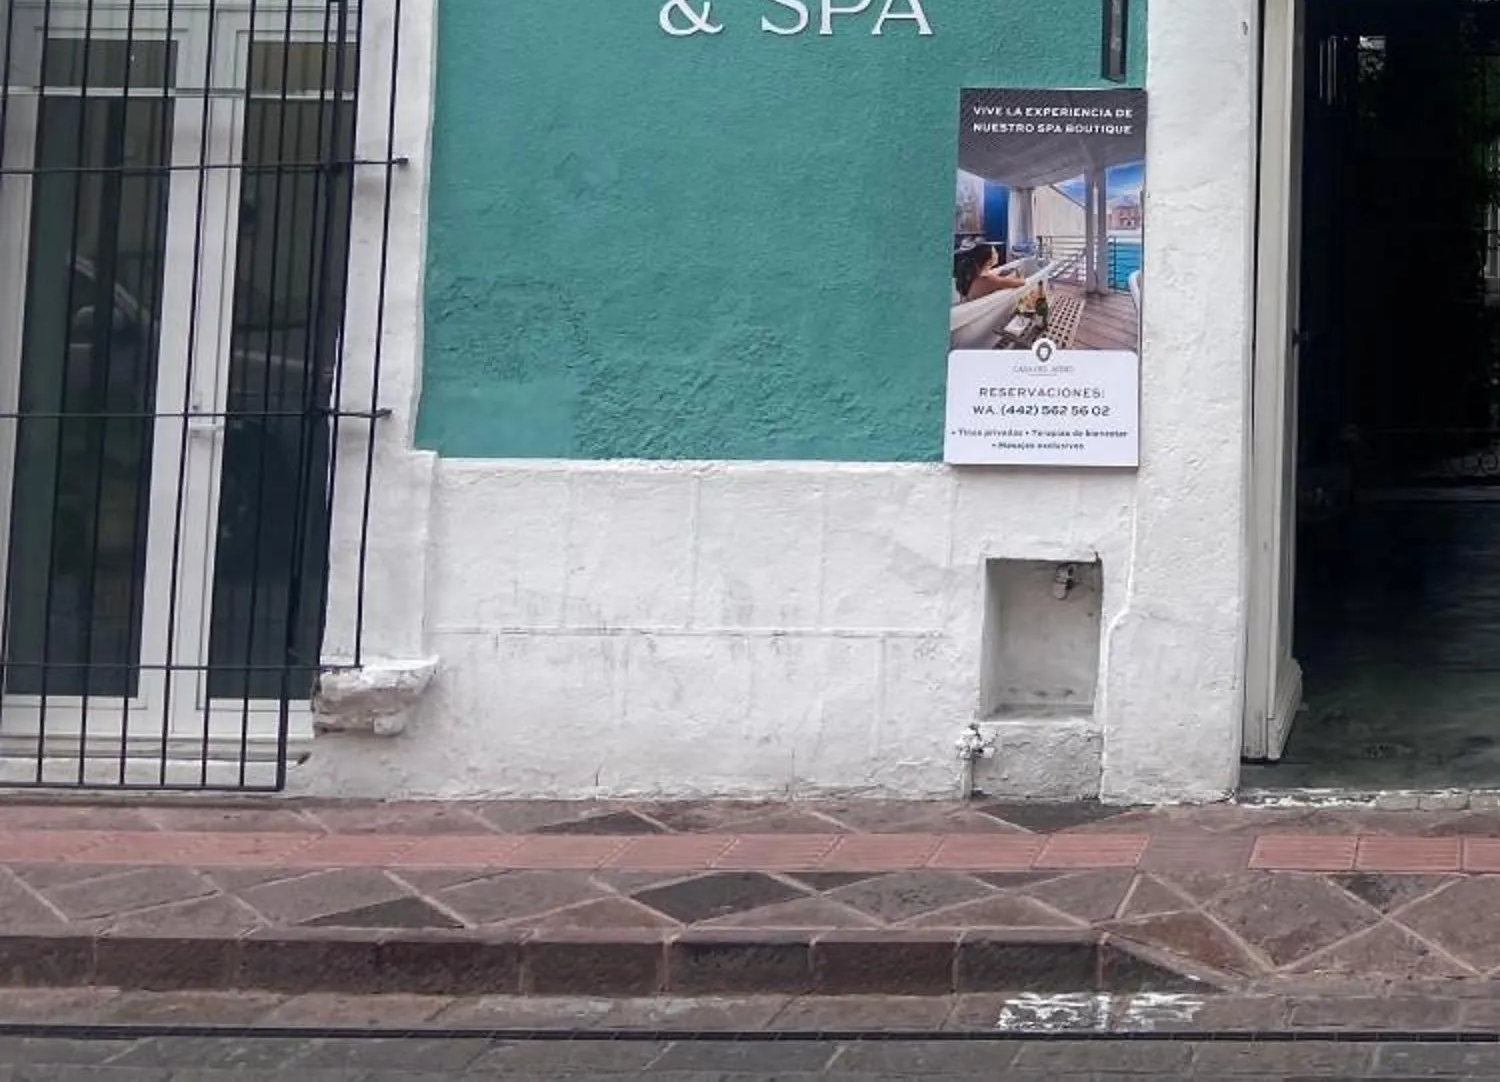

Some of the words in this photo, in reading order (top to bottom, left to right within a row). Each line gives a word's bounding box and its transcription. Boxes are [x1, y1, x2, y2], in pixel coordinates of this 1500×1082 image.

[973, 105, 1001, 116] VIVE
[1005, 106, 1022, 117] LA
[1025, 106, 1113, 118] EXPERIENCIA
[1115, 108, 1133, 119] DE
[973, 122, 1035, 133] NUESTRO
[1036, 123, 1063, 133] SPA
[1065, 123, 1133, 135] BOUTIQUE
[979, 386, 1105, 399] RESERVACIONES:
[1001, 404, 1039, 417] (442)
[1040, 405, 1069, 416] 562
[1071, 405, 1089, 417] 56
[1091, 405, 1111, 417] 02
